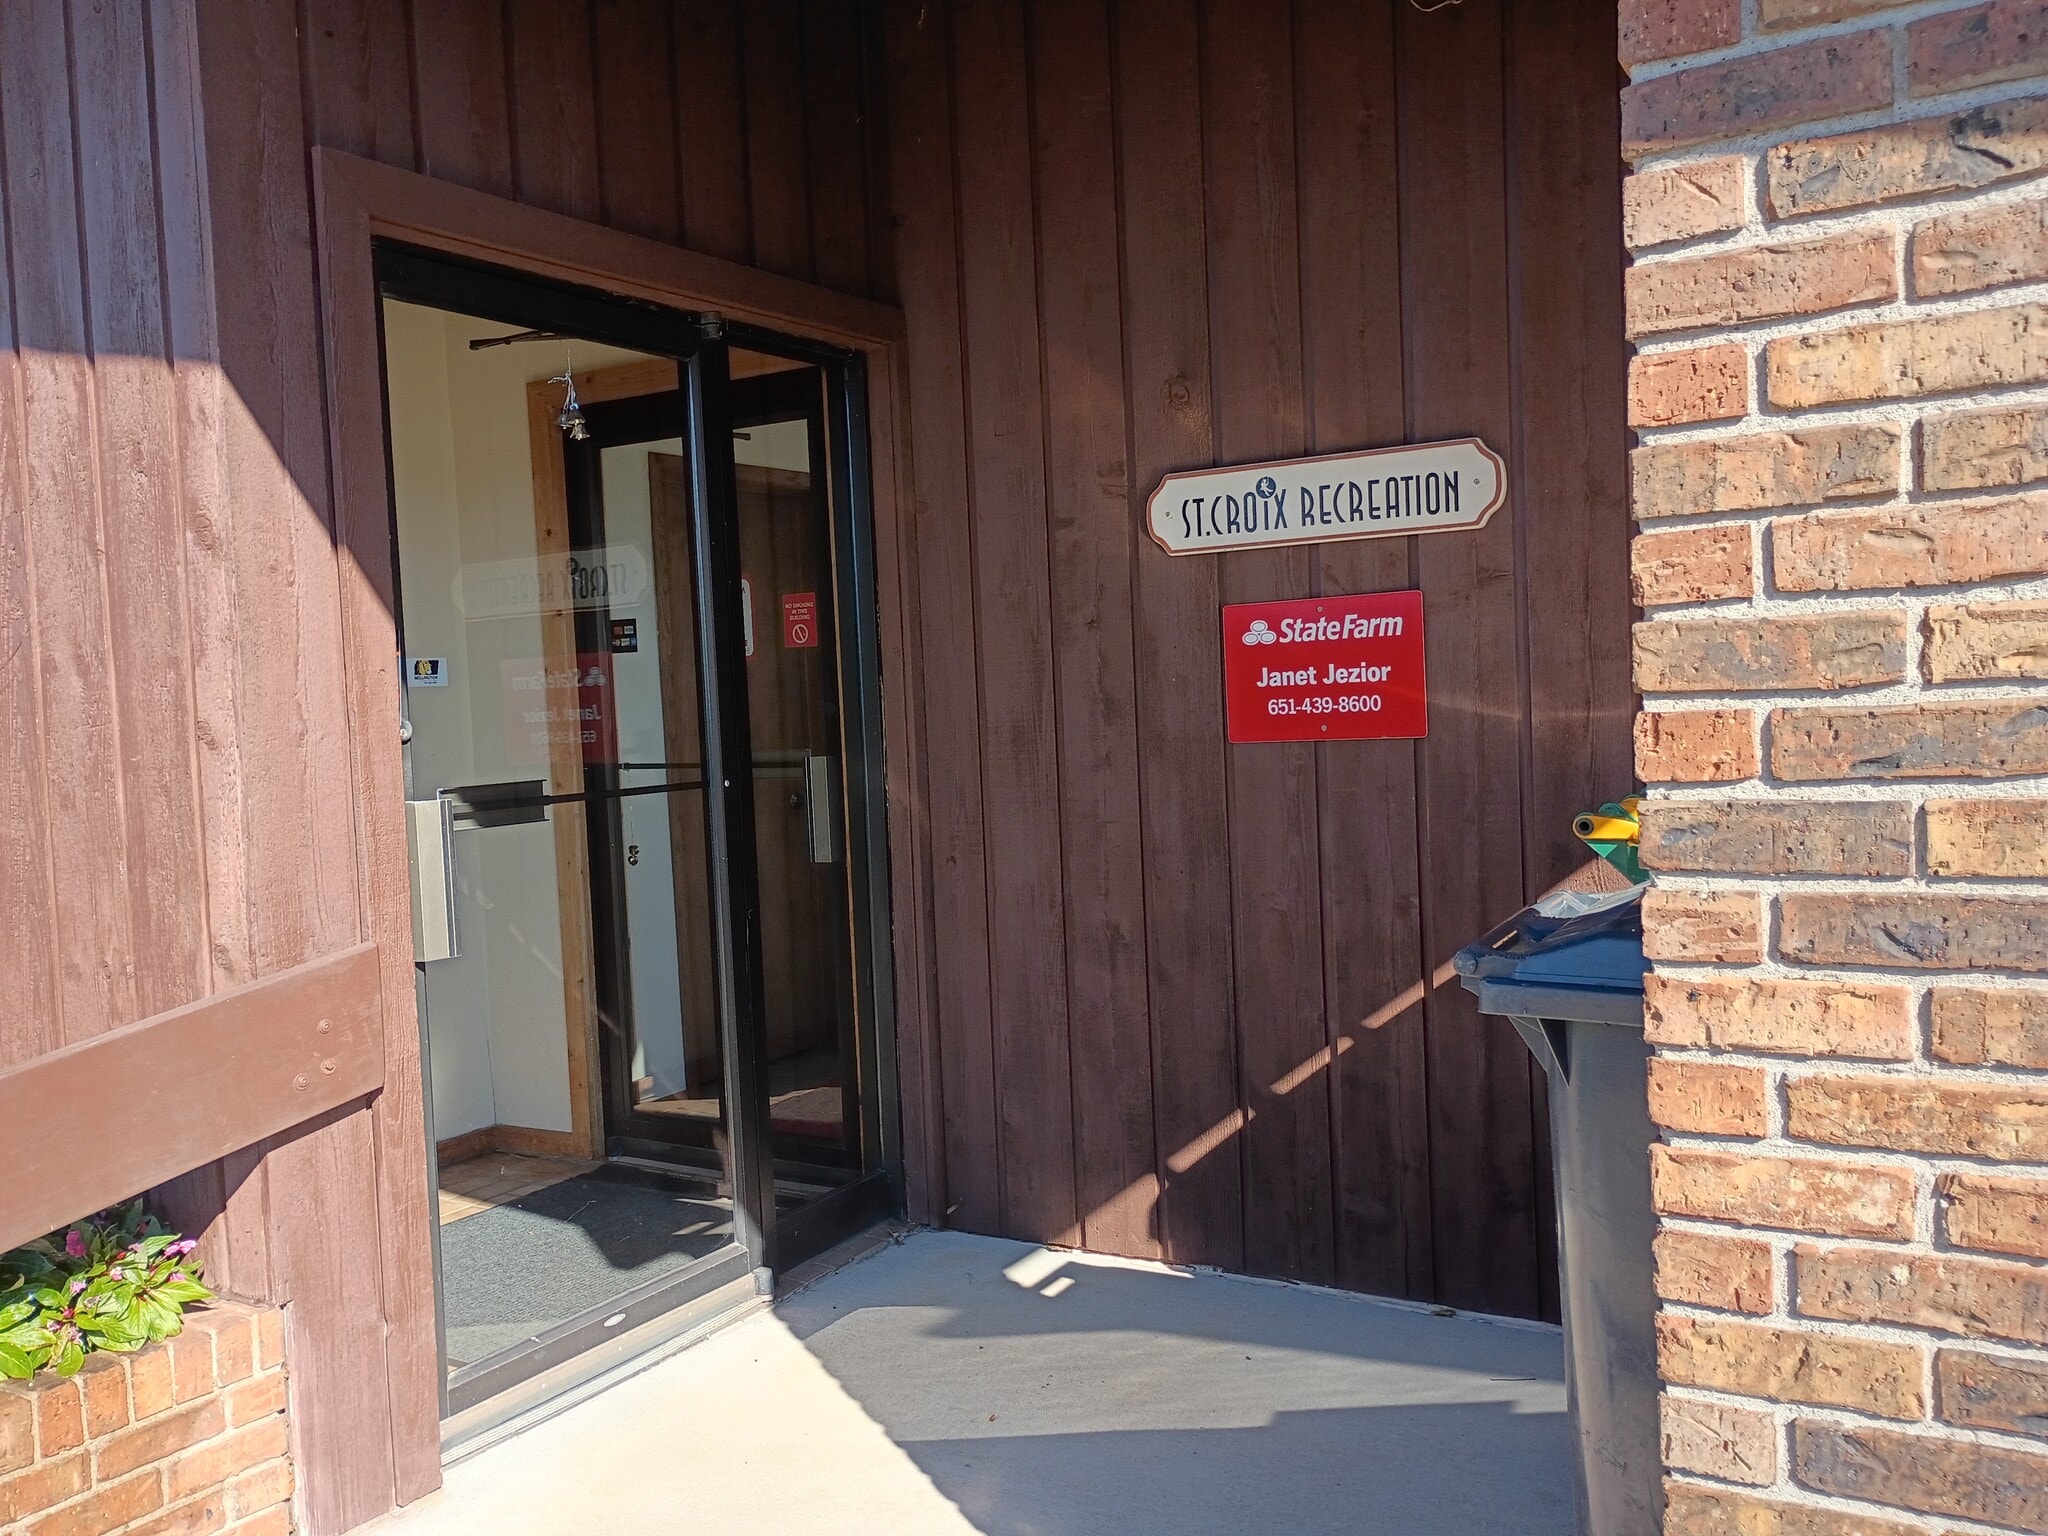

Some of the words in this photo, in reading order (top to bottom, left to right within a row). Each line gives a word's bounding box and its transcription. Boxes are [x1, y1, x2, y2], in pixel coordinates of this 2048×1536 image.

[1300, 470, 1461, 528] RECREATION
[1256, 666, 1318, 688] Janet
[1322, 661, 1392, 685] Jezior
[1267, 694, 1382, 716] 651-439-8600
